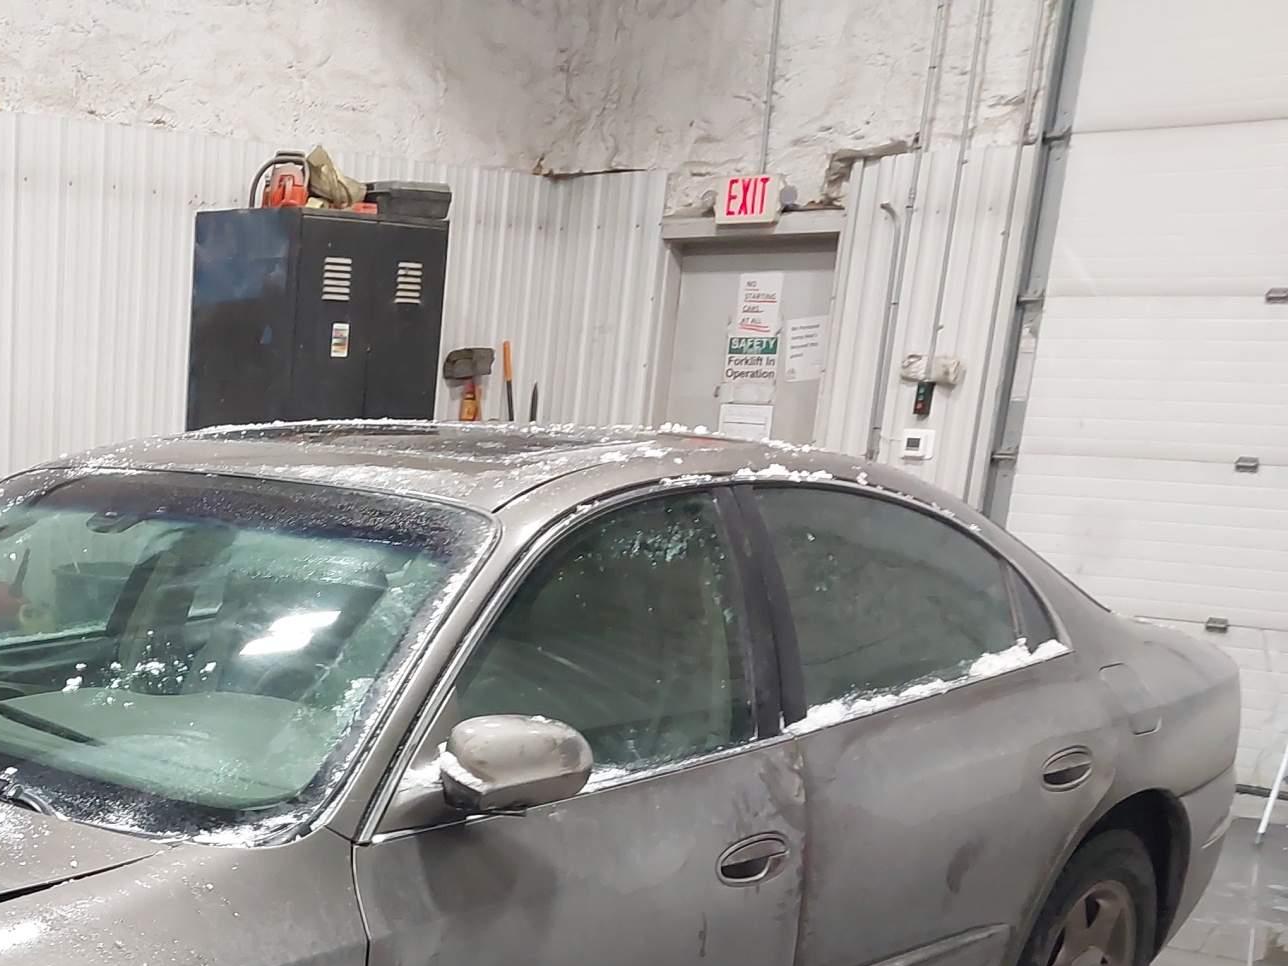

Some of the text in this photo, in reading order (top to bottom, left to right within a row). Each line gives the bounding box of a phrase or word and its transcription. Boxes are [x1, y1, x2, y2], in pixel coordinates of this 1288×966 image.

[725, 177, 771, 216] EXIT
[731, 338, 777, 349] SAFETY
[728, 356, 776, 367] Forklift In
[725, 367, 775, 380] Operation
